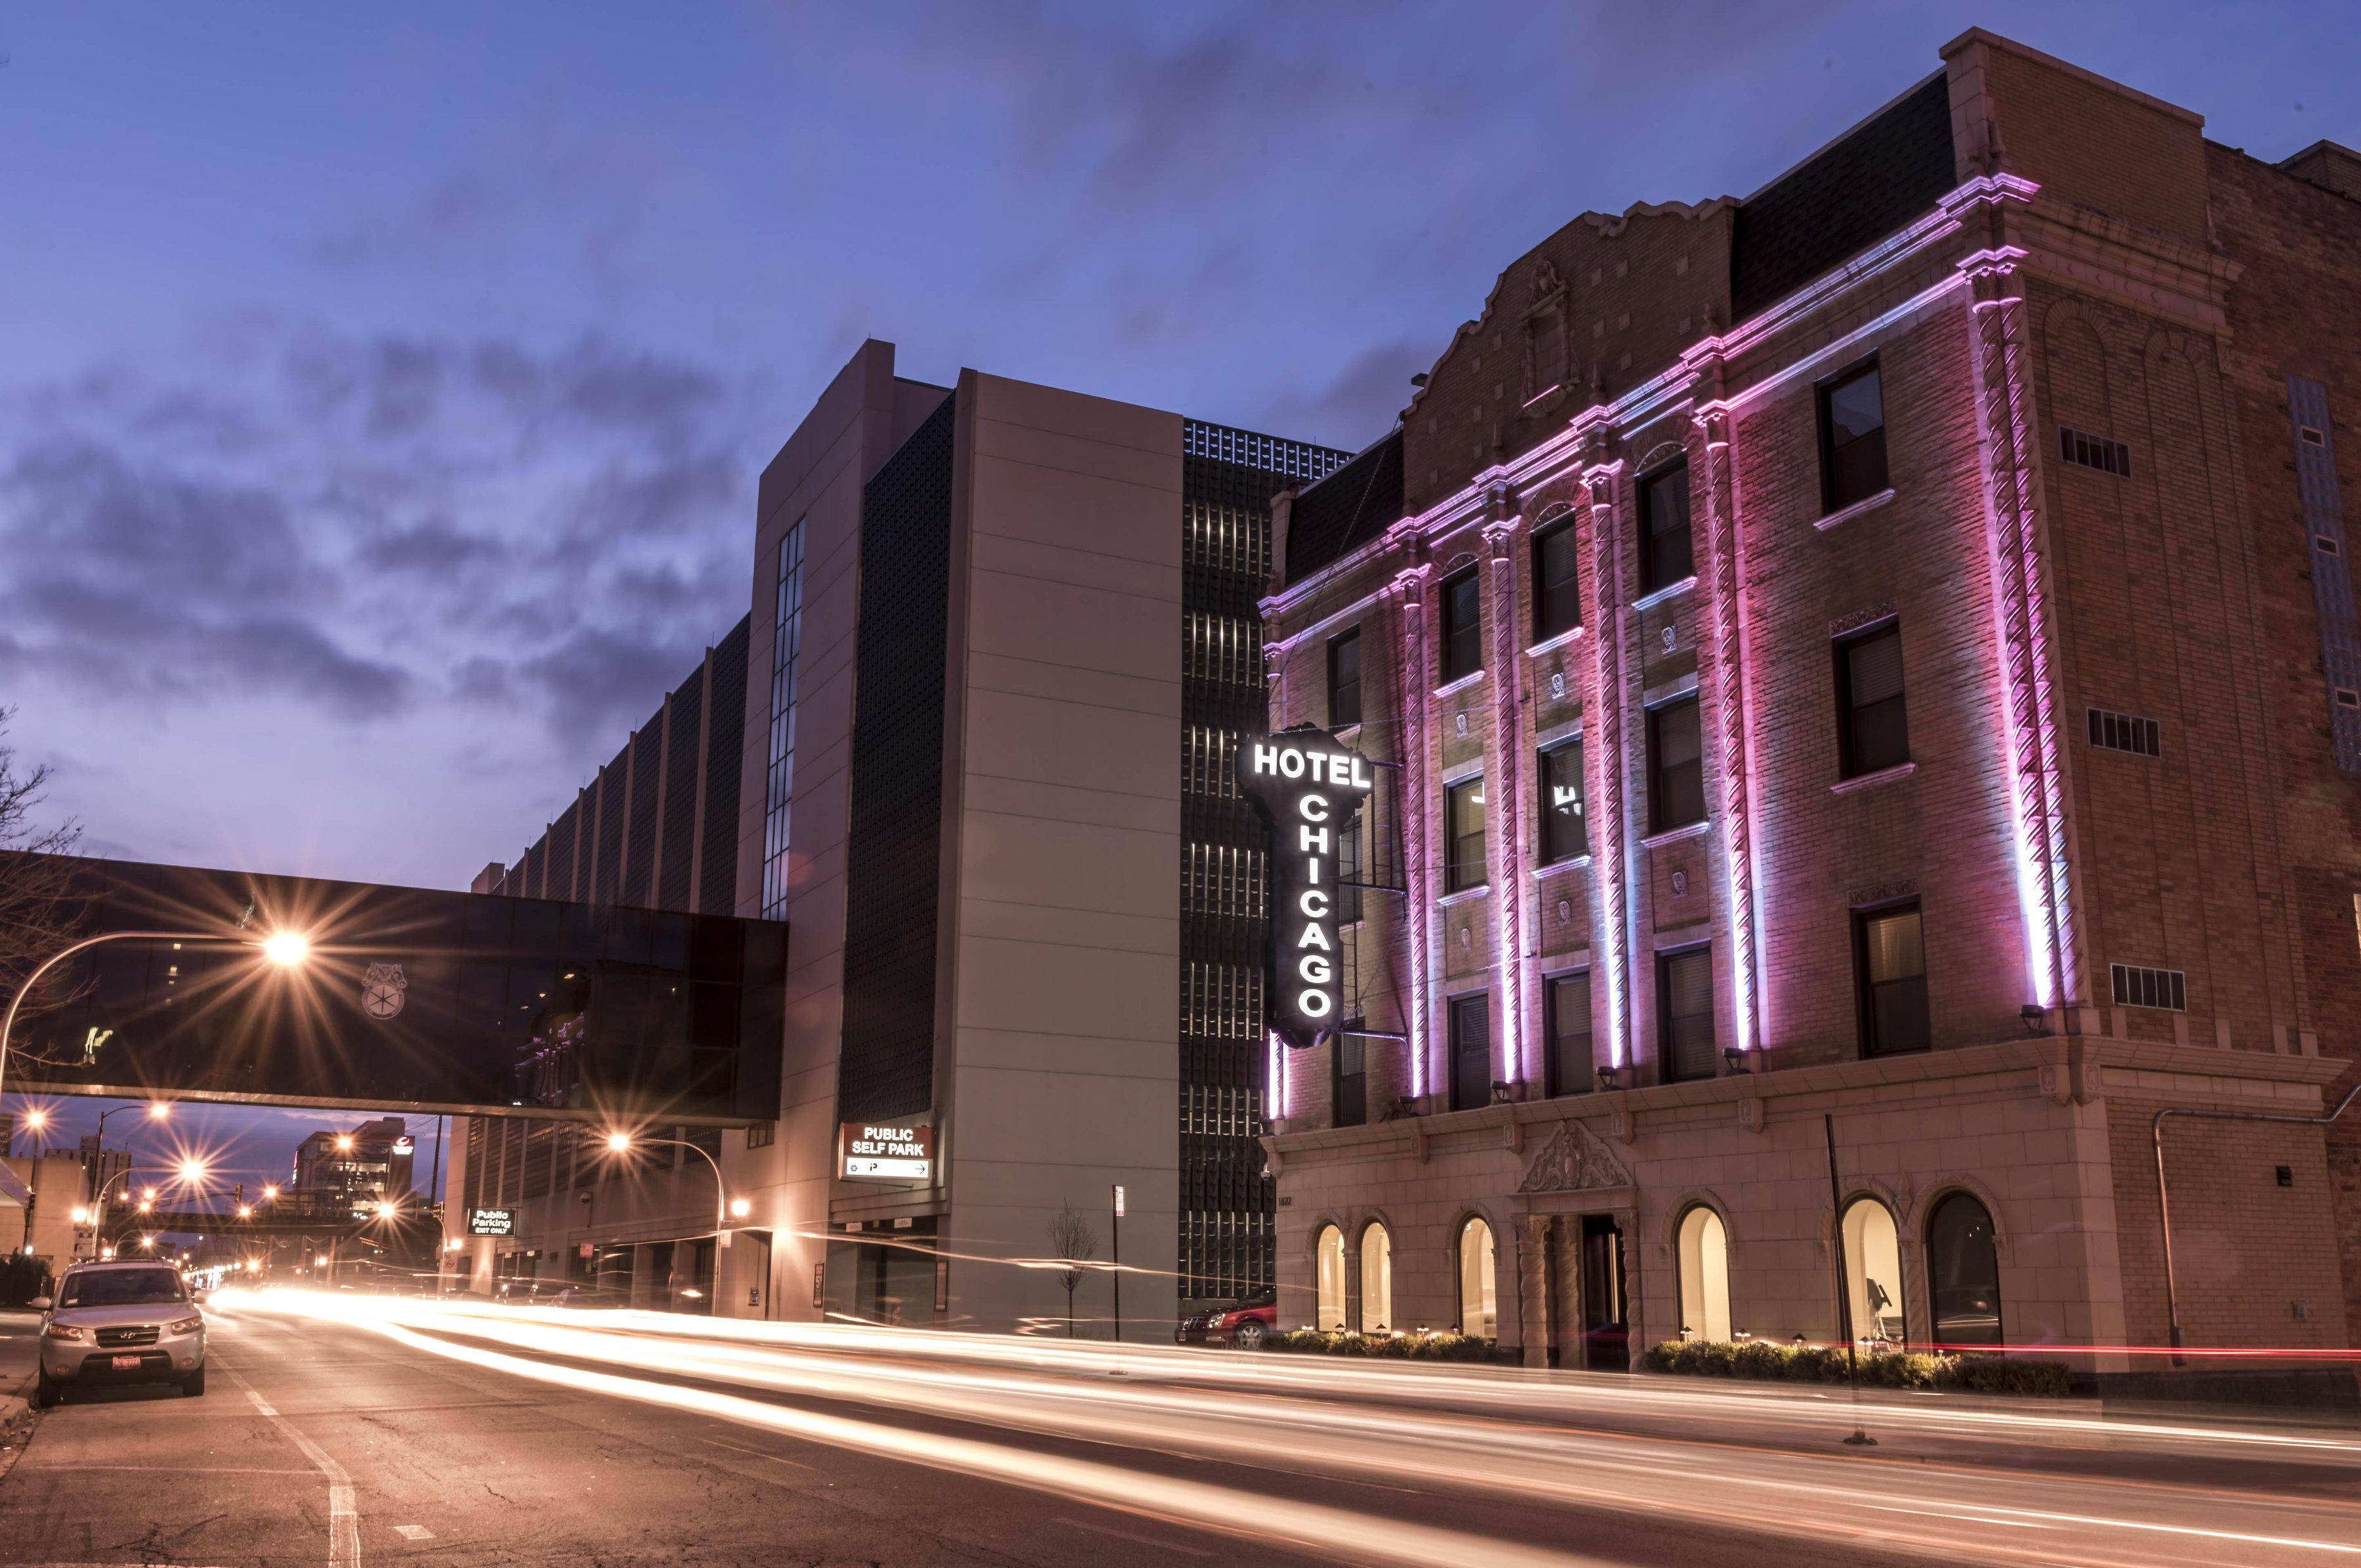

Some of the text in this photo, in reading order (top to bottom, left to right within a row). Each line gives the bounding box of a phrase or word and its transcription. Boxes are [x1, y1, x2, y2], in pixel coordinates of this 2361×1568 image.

[1253, 744, 1371, 789] HOTEL
[1297, 794, 1331, 1018] CHICAGO
[864, 1127, 914, 1142] PUBLIC
[852, 1141, 924, 1156] SELF PARK
[476, 1210, 509, 1220] Public
[472, 1218, 511, 1228] Parking
